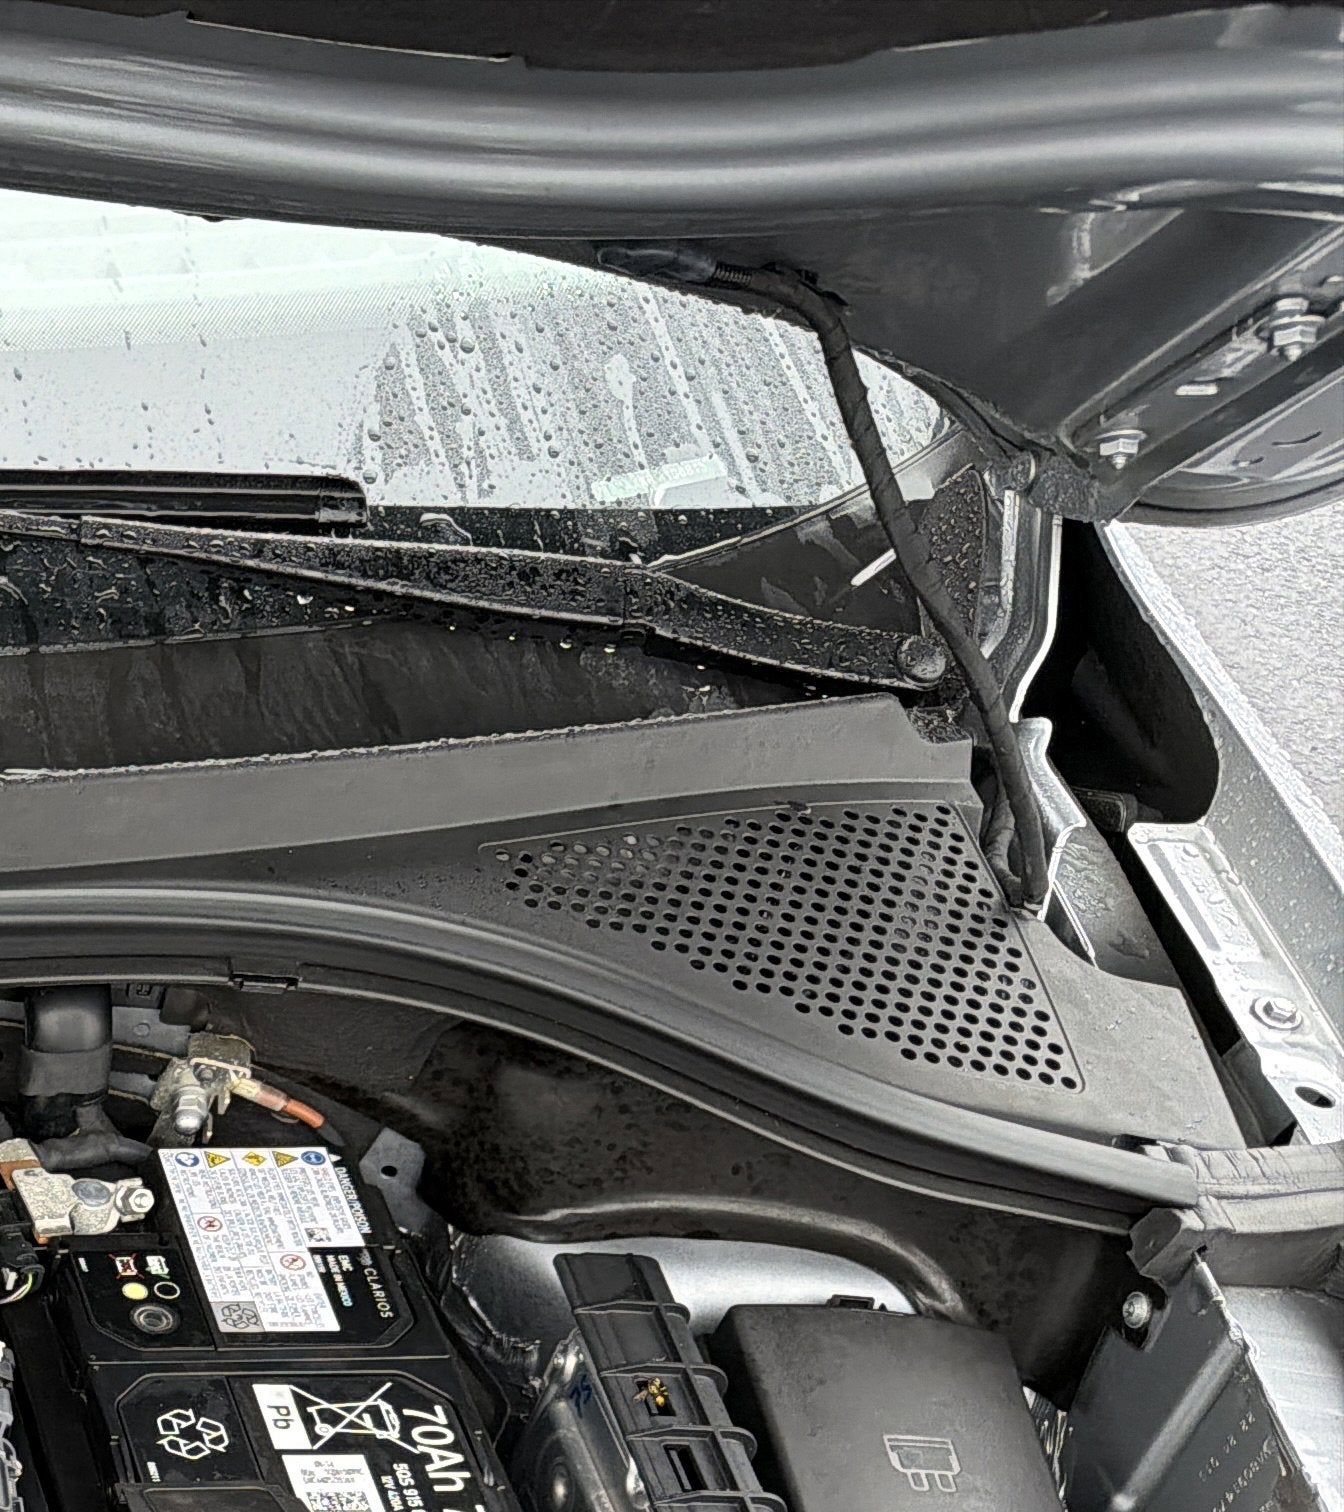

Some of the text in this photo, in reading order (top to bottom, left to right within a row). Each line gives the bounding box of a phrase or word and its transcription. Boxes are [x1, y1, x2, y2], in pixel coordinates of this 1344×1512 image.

[334, 1166, 372, 1234] DANGER/POISON
[364, 1267, 394, 1318] CLARIOS
[266, 1404, 297, 1430] Pb
[402, 1404, 472, 1492] 70Ah
[403, 1489, 424, 1508] 915
